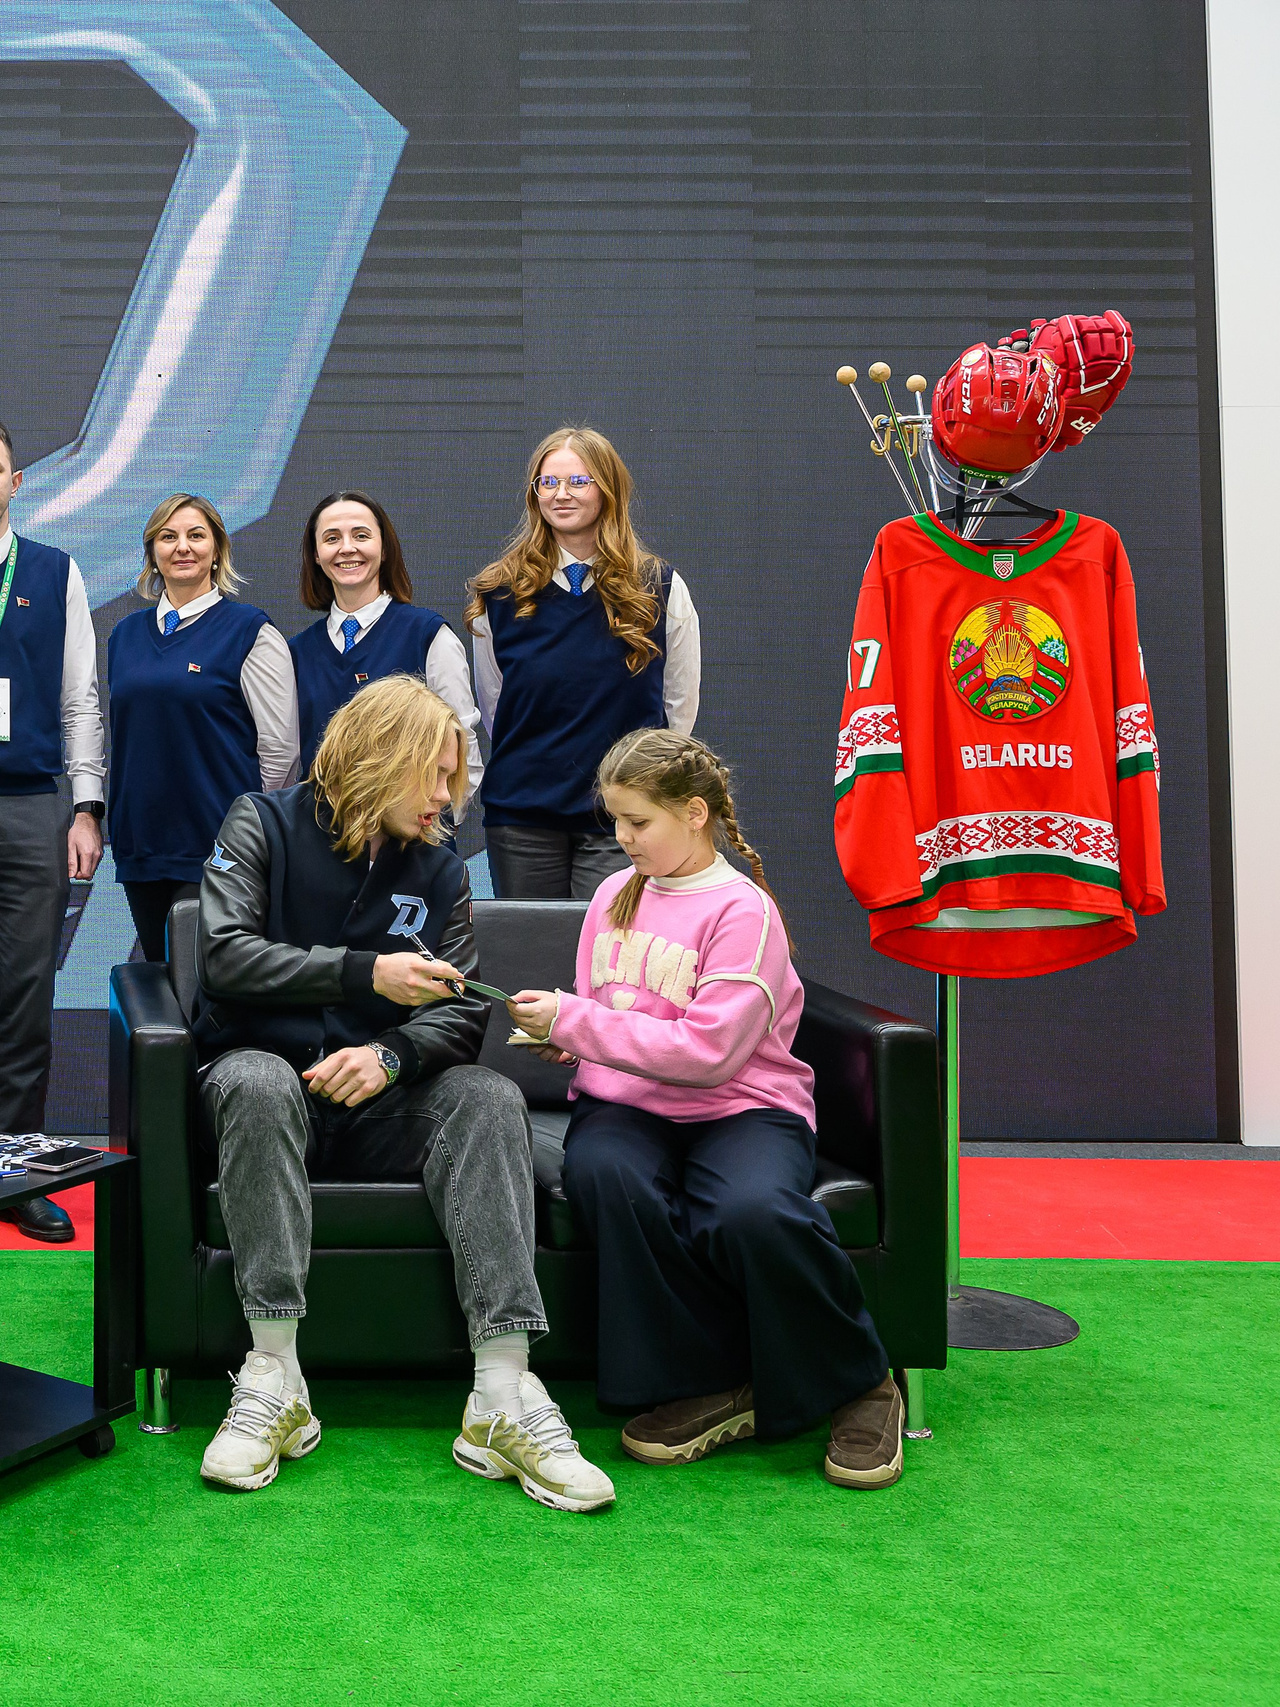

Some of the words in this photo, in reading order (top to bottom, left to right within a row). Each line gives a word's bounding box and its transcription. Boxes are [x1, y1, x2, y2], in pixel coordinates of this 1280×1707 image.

[960, 367, 973, 415] CCM
[989, 701, 1031, 712] БЕЛАРУСЬ
[960, 743, 1073, 770] BELARUS
[386, 893, 429, 938] D
